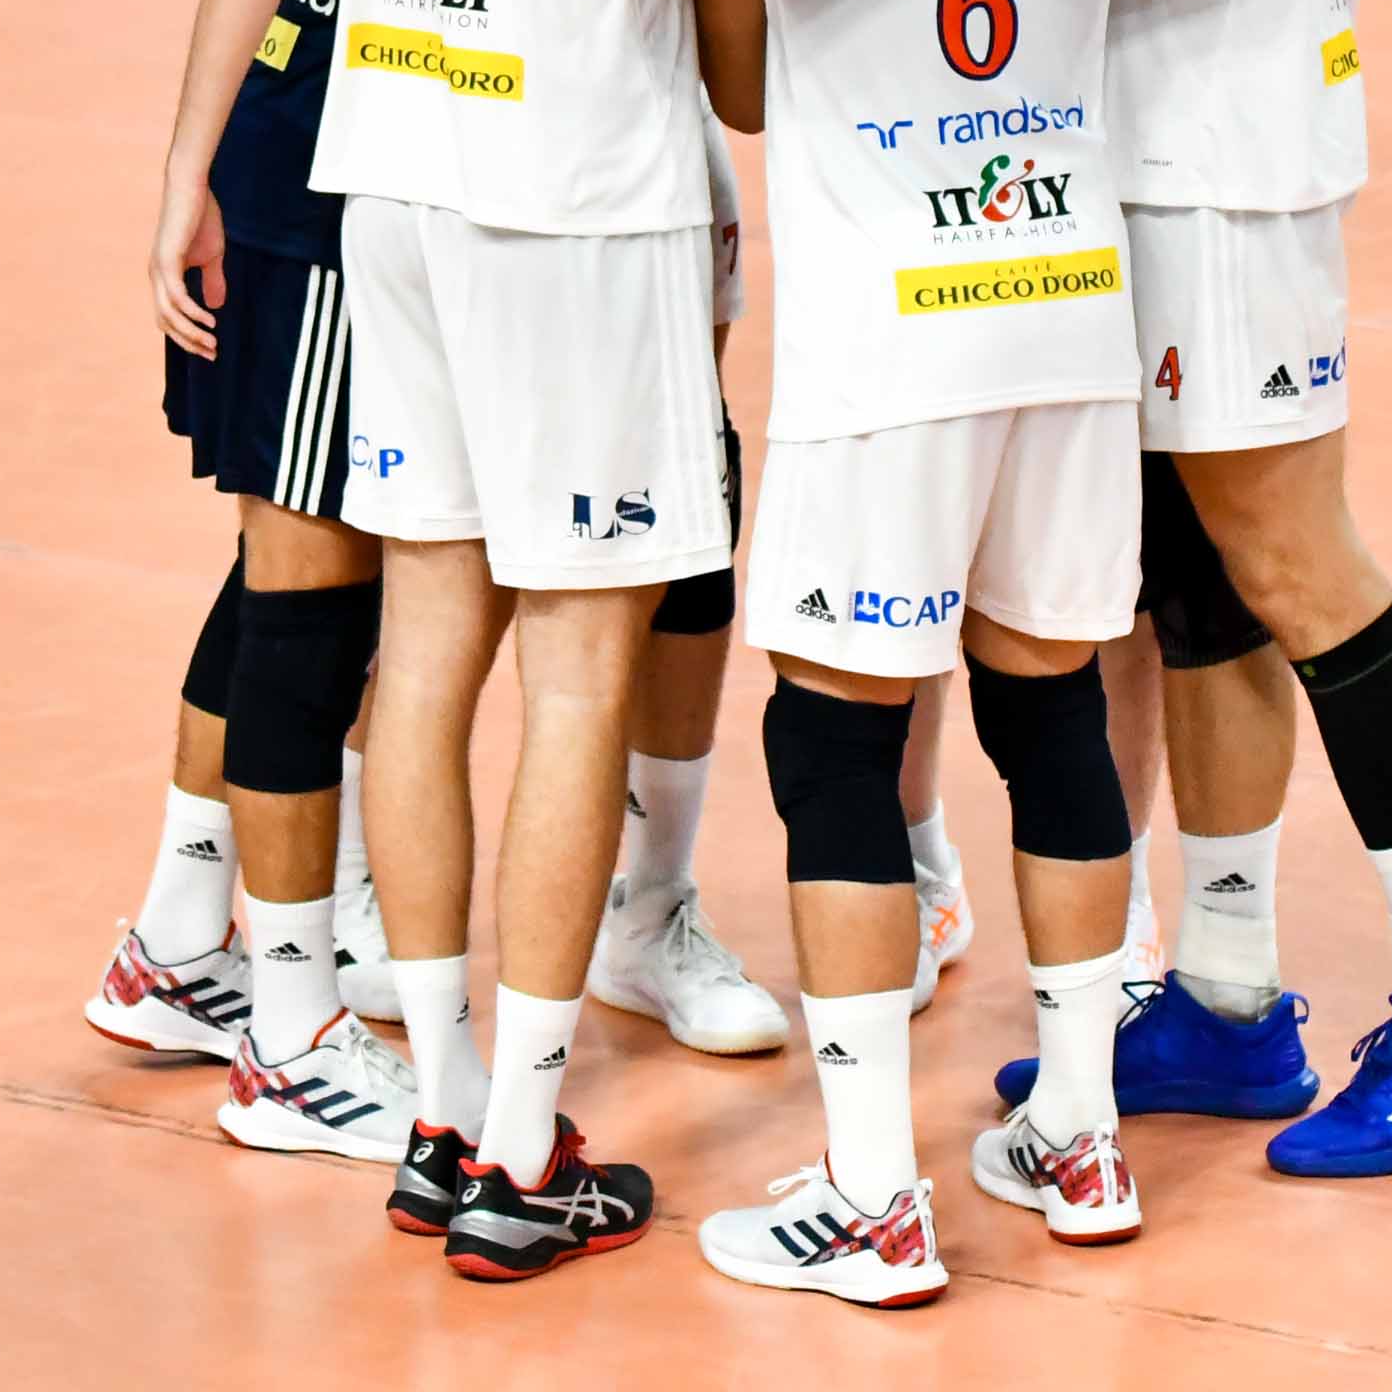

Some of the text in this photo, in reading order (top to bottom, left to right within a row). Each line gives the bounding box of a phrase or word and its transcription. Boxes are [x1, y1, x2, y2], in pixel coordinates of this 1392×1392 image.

[933, 221, 1078, 245] HAIRFAHION
[915, 269, 1115, 308] CHICCO D'ORO
[1155, 346, 1183, 401] 4
[1260, 384, 1300, 399] adidas
[795, 603, 837, 625] adidas
[882, 590, 961, 628] CAP
[176, 847, 224, 863] adidas
[1204, 884, 1256, 894] adidas
[264, 952, 312, 963] adidas
